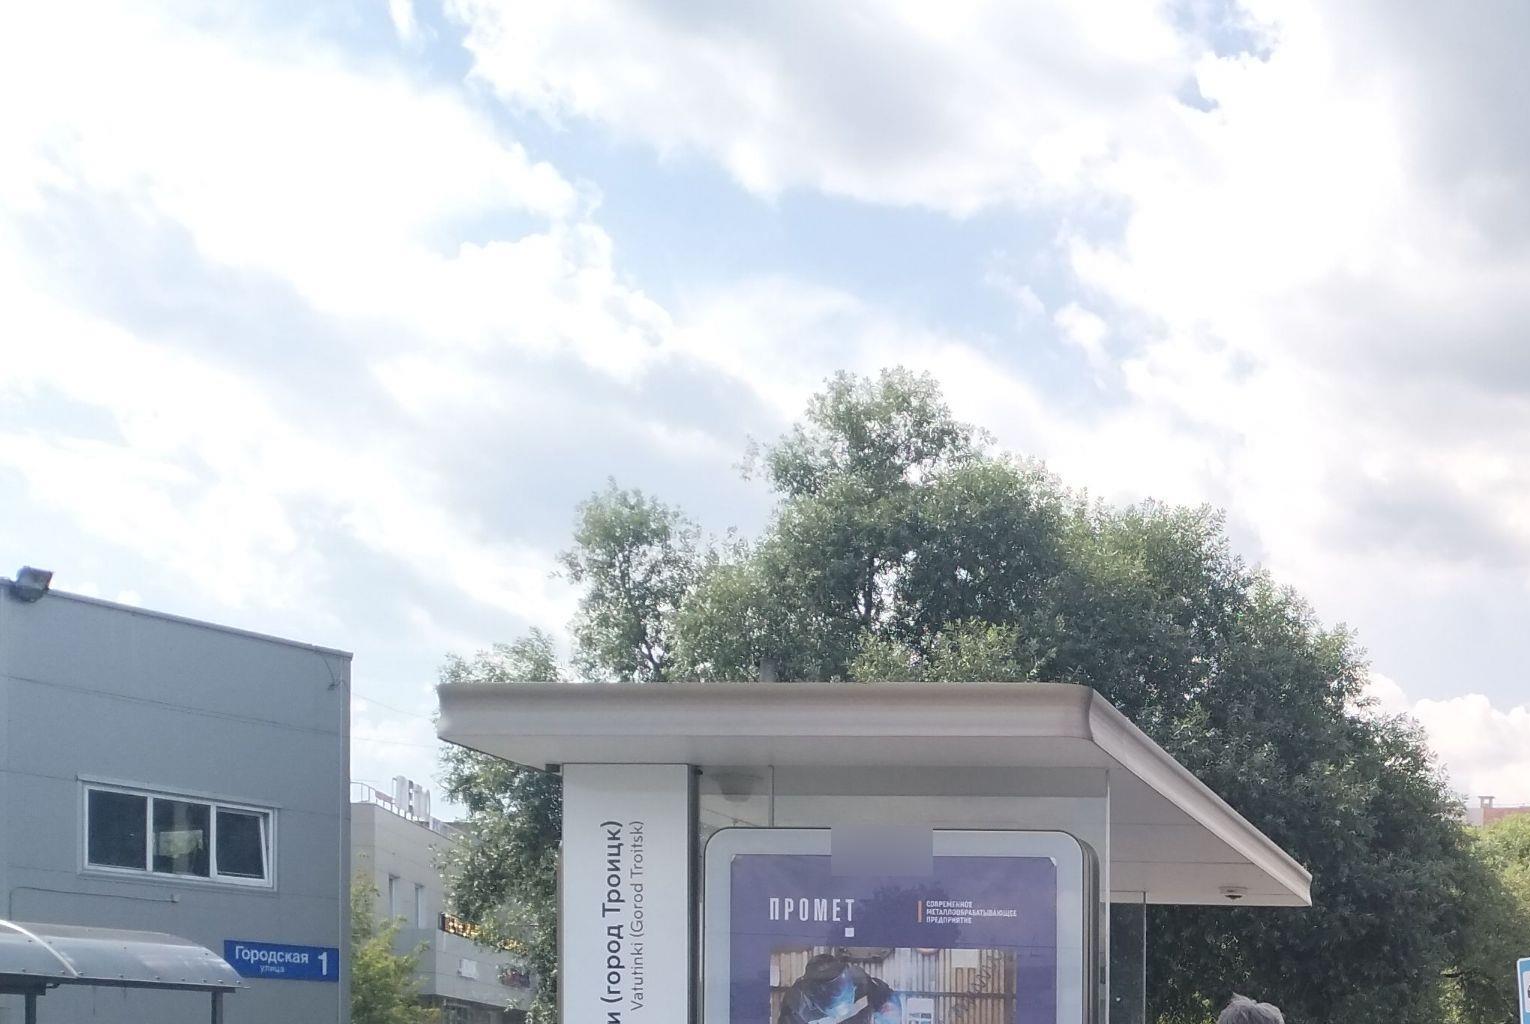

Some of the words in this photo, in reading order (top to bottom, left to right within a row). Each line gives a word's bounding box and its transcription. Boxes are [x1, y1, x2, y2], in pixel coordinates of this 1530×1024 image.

[600, 821, 625, 918] Троицк)
[629, 821, 644, 879] Troitsk)
[629, 883, 644, 937] (Gorod
[769, 897, 855, 922] ПРОМЕТ
[235, 945, 309, 964] Городская
[260, 965, 285, 974] улица
[317, 951, 328, 976] 1
[600, 924, 625, 1003] (город
[630, 942, 644, 1011] Vatutinki
